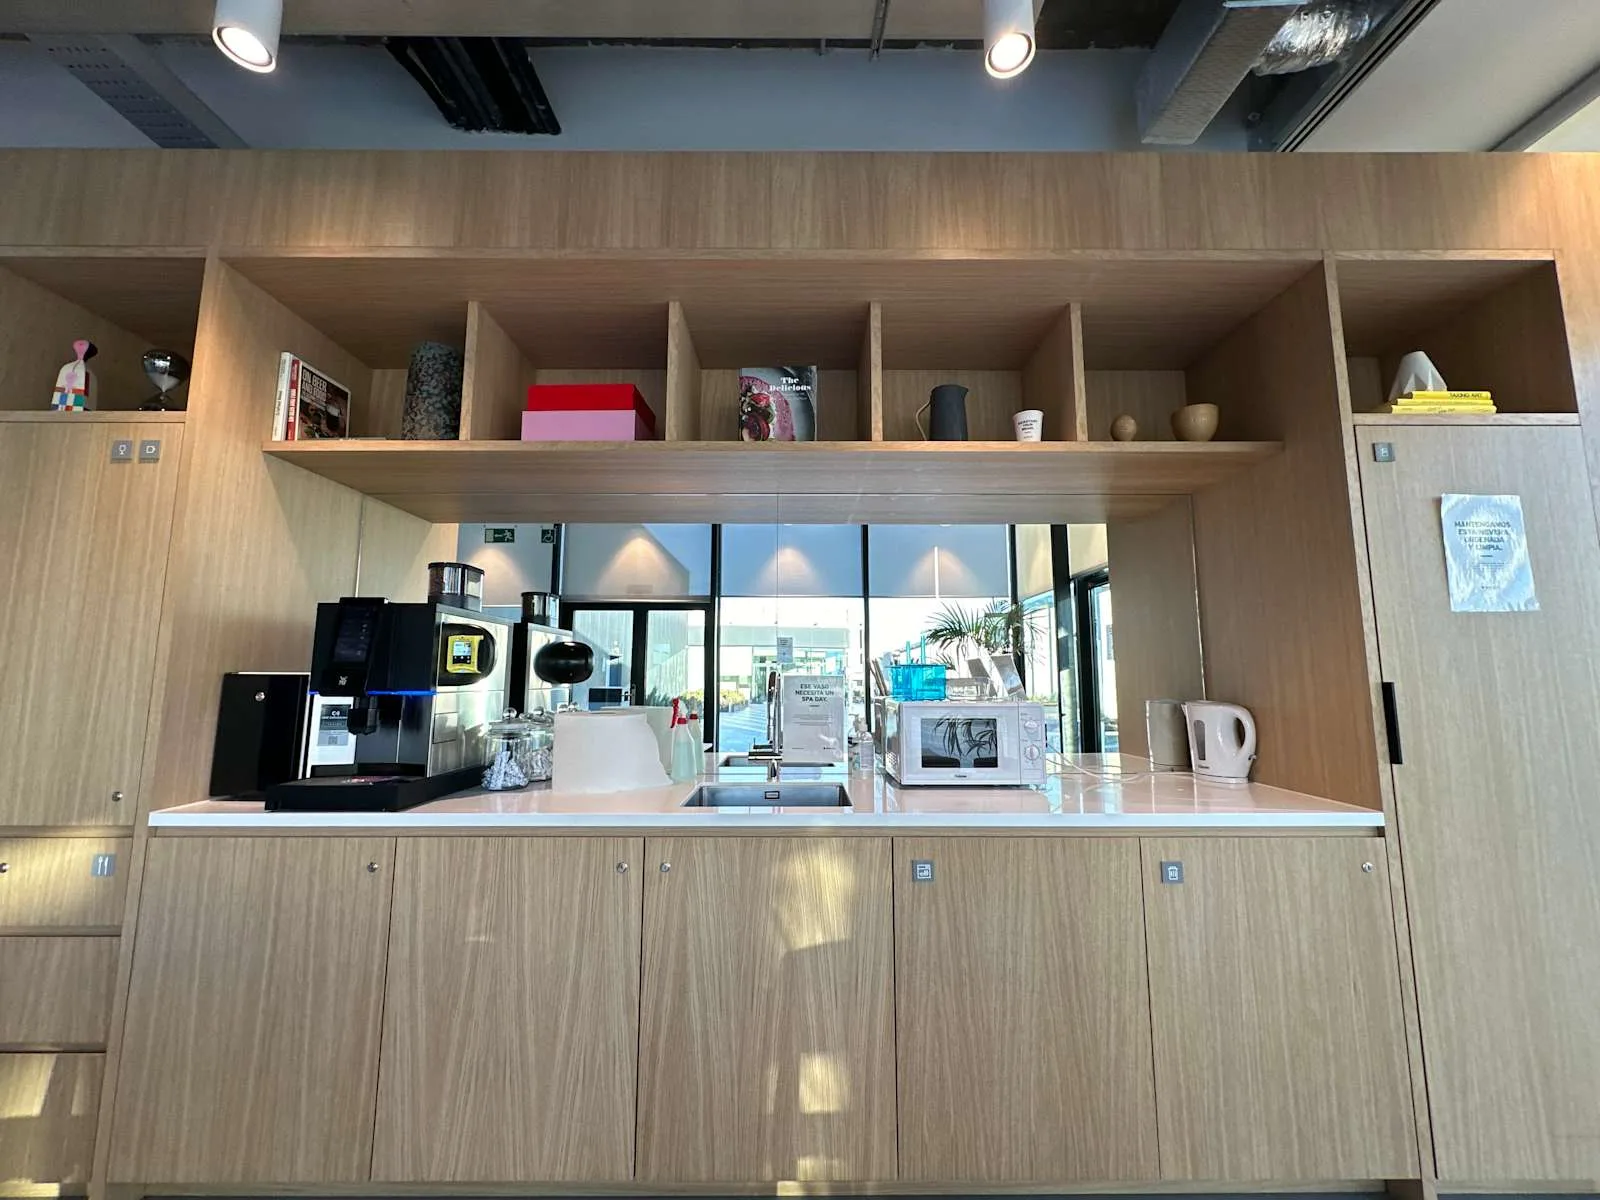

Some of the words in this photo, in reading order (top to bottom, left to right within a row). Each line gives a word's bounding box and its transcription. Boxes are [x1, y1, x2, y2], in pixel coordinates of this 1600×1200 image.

[303, 370, 311, 384] ON
[312, 375, 327, 392] BEER
[780, 376, 799, 384] The
